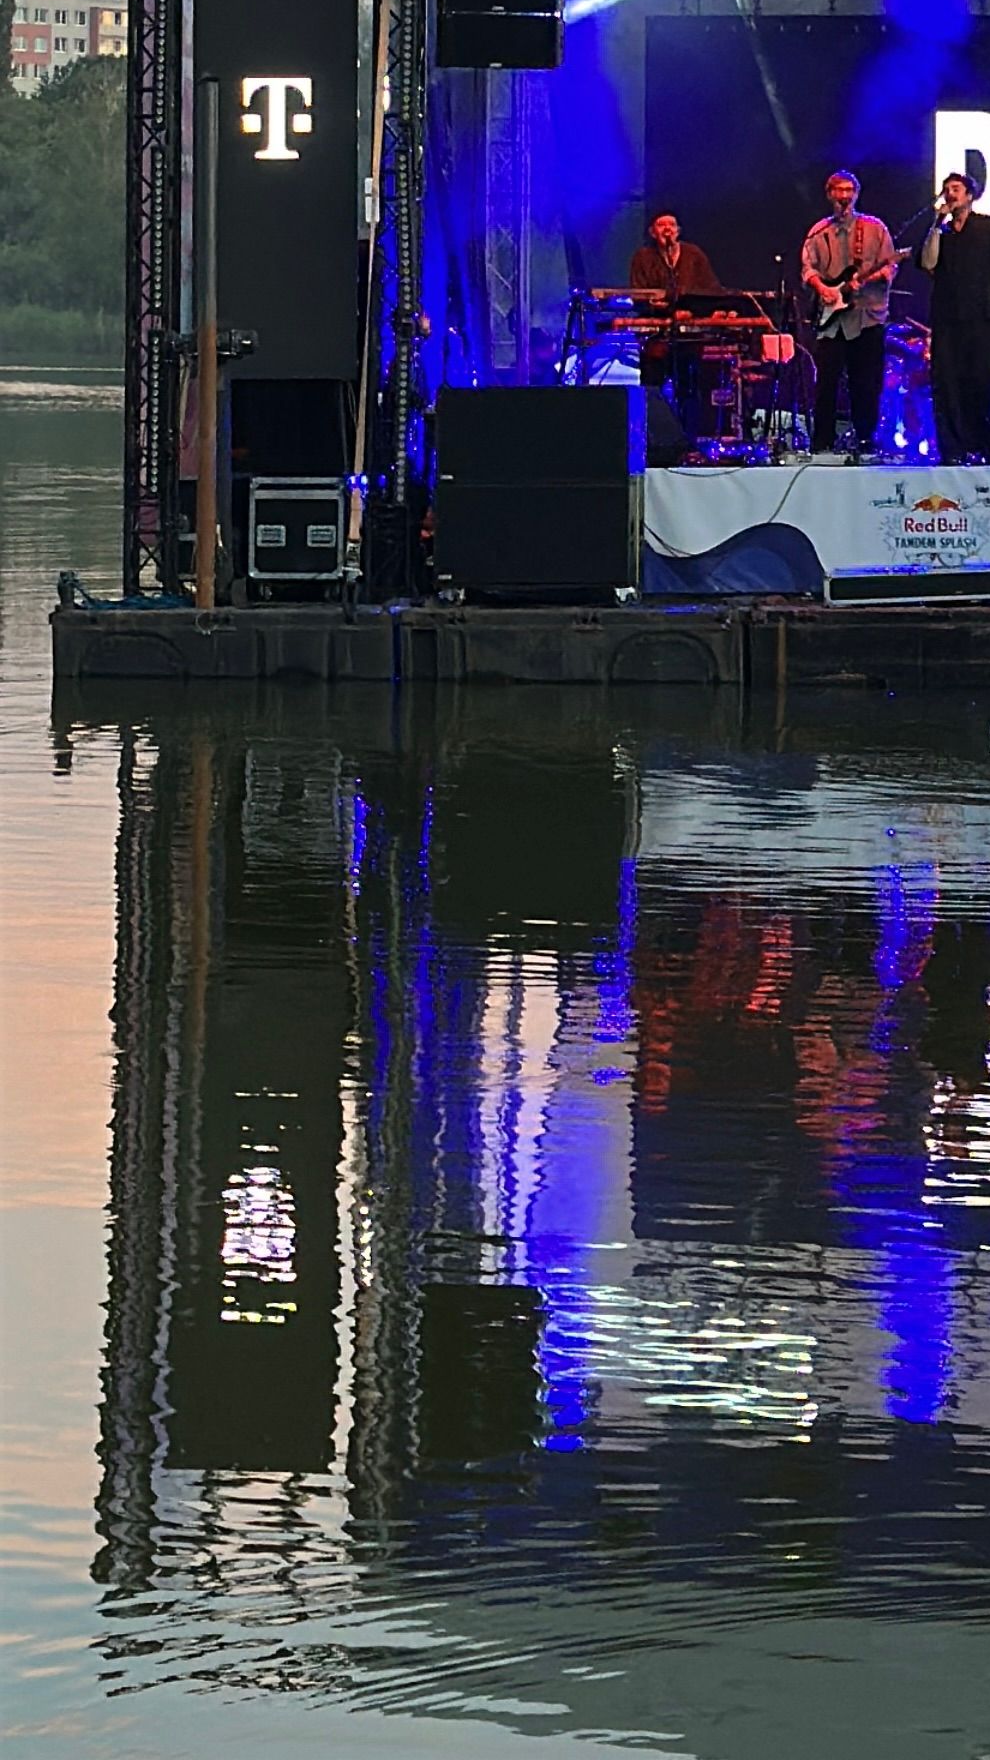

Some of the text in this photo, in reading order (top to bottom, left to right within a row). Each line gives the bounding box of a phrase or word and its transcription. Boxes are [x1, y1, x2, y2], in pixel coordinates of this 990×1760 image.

[241, 77, 312, 159] T
[904, 517, 968, 533] Red Bull
[894, 536, 978, 549] TANDEM SPLASH
